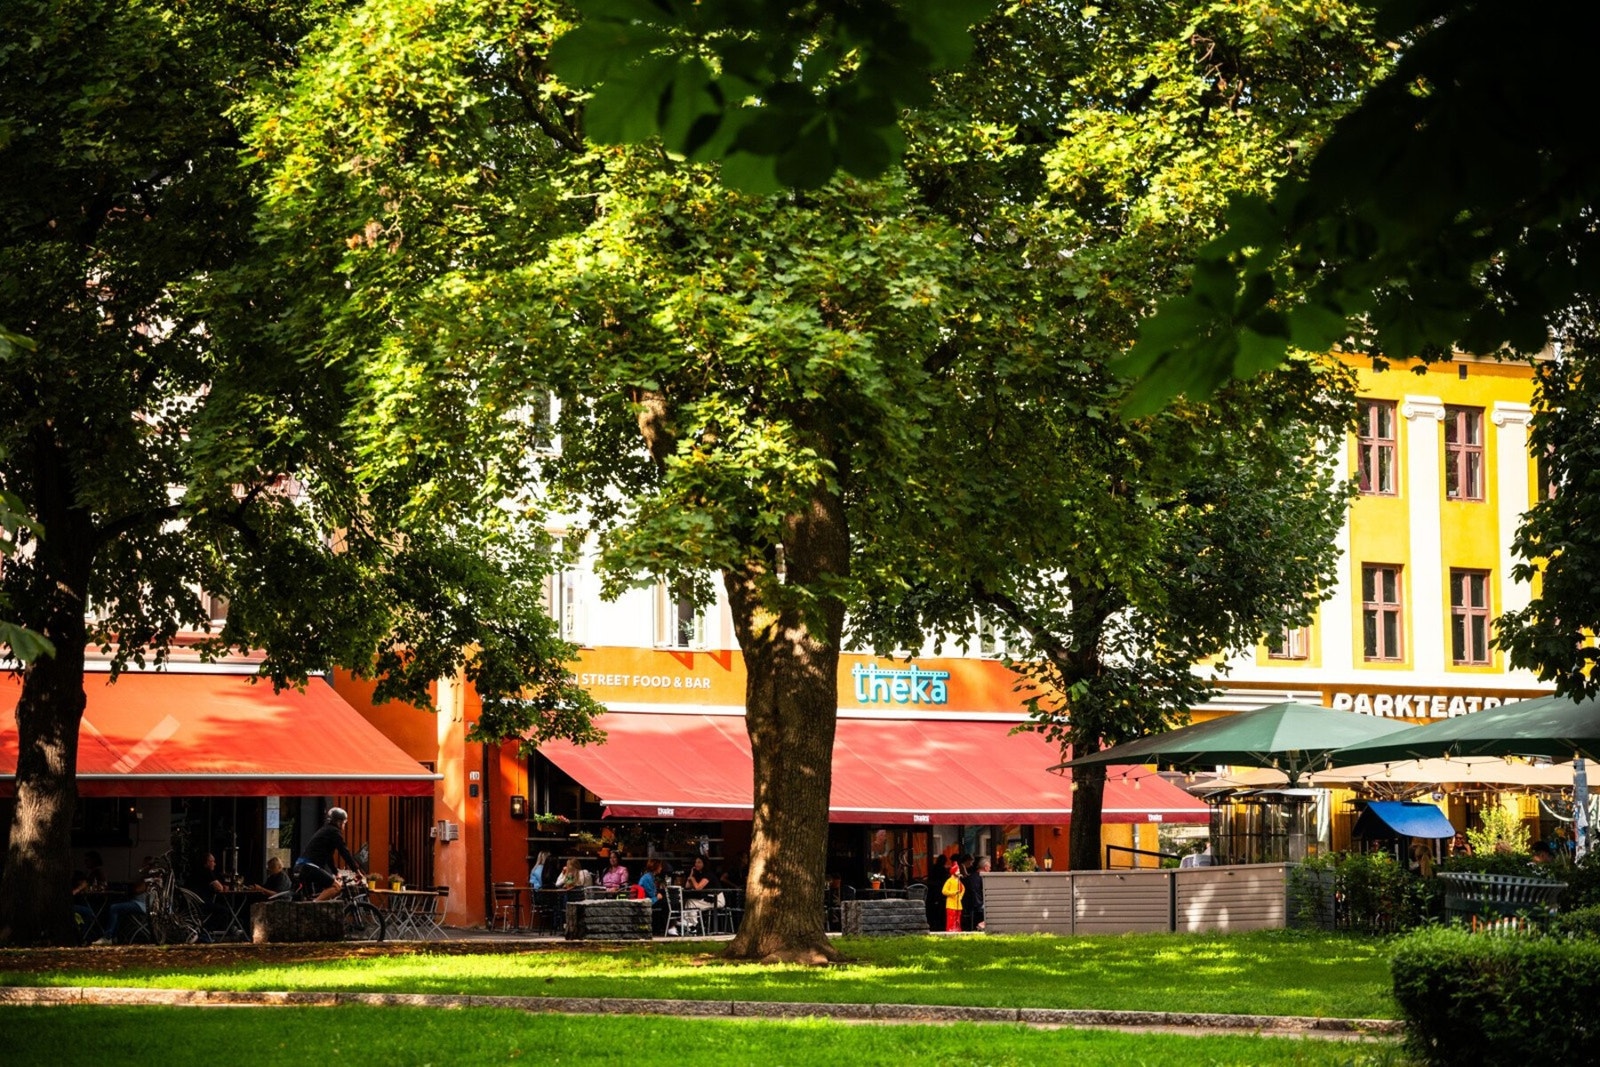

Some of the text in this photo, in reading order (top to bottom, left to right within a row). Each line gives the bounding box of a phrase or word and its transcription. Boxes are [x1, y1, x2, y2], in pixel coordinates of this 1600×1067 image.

[581, 673, 630, 686] STREET
[632, 675, 671, 688] FOOD
[673, 676, 682, 688] &
[684, 677, 711, 689] BAR
[852, 662, 949, 705] theka
[1333, 693, 1533, 718] PARKTEATR
